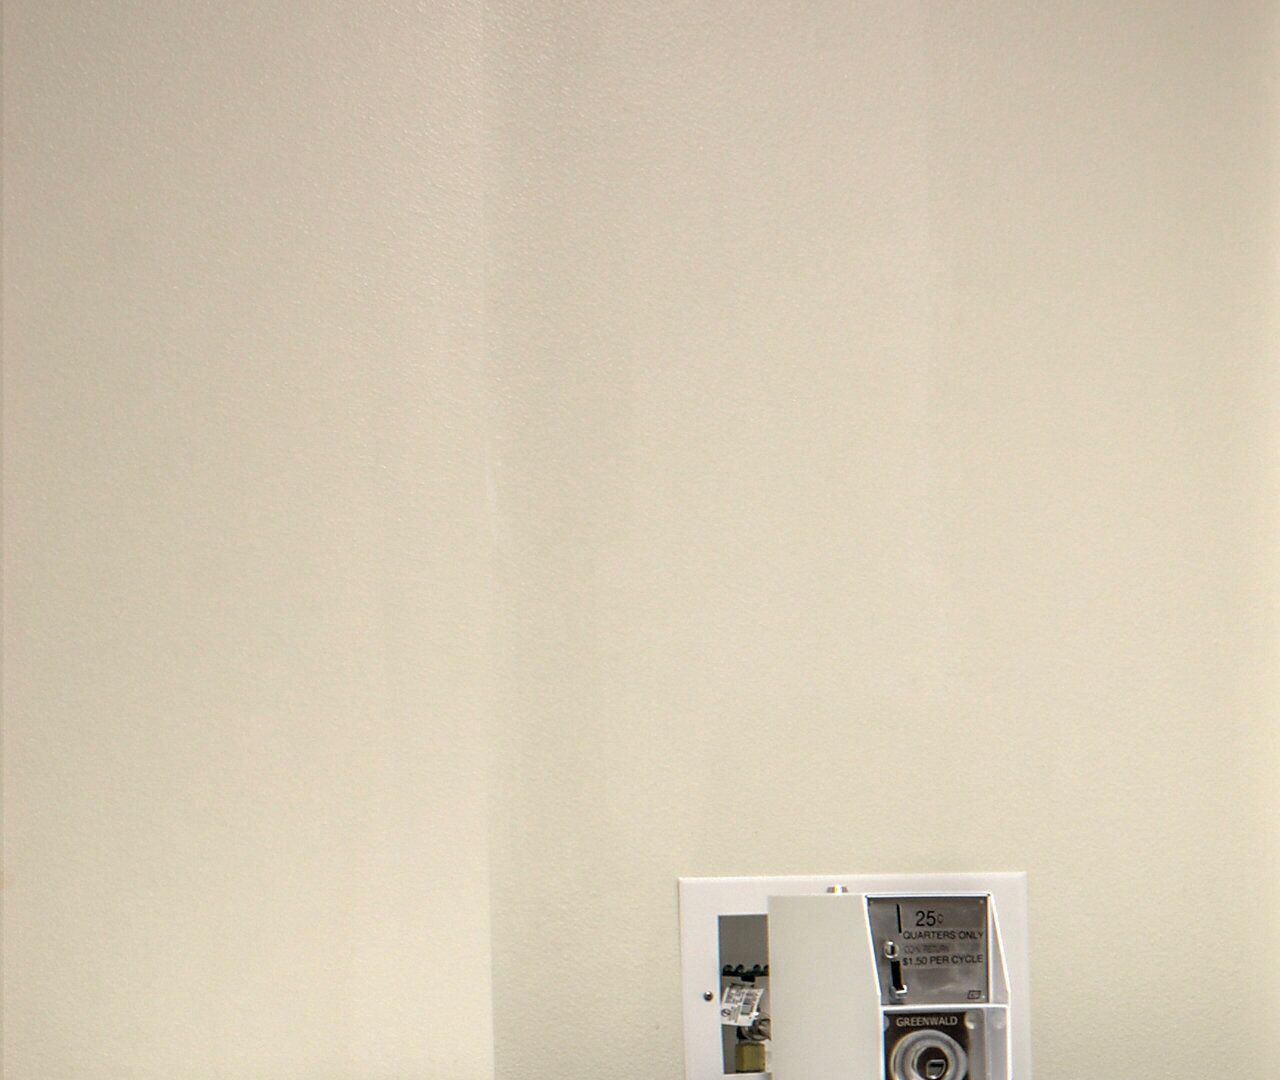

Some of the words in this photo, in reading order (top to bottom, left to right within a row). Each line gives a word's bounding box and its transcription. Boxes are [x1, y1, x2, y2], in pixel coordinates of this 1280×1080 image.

[903, 931, 956, 940] QUARTERS
[959, 931, 983, 939] ONLY
[930, 956, 949, 965] PER
[951, 955, 983, 964] CYCLE
[896, 1017, 958, 1027] GREENWALD
